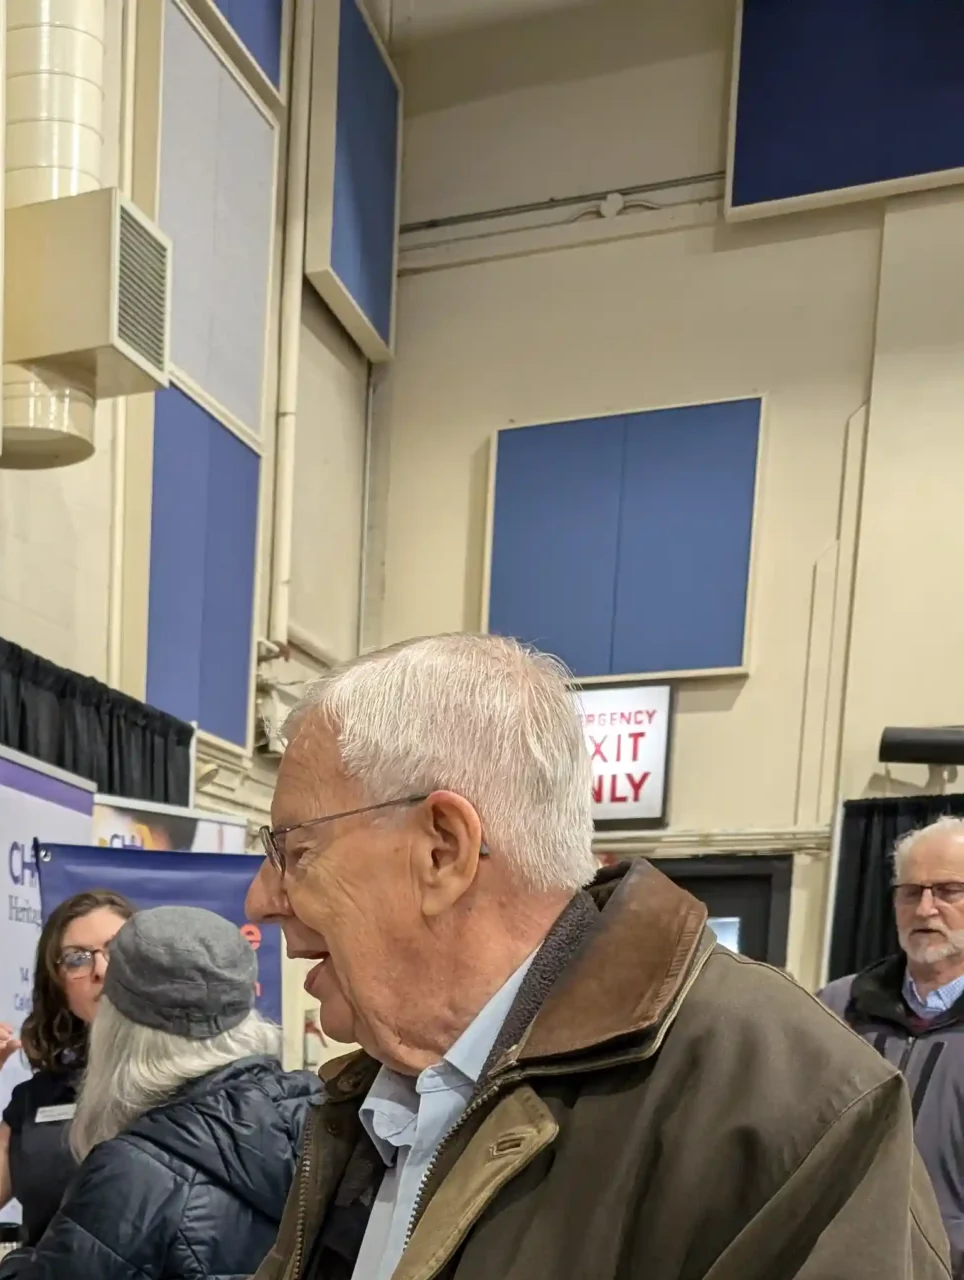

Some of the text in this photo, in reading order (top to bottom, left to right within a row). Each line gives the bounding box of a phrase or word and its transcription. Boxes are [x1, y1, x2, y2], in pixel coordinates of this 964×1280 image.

[577, 709, 658, 727] RGENCY
[589, 732, 646, 763] XIT
[591, 771, 652, 804] NLY
